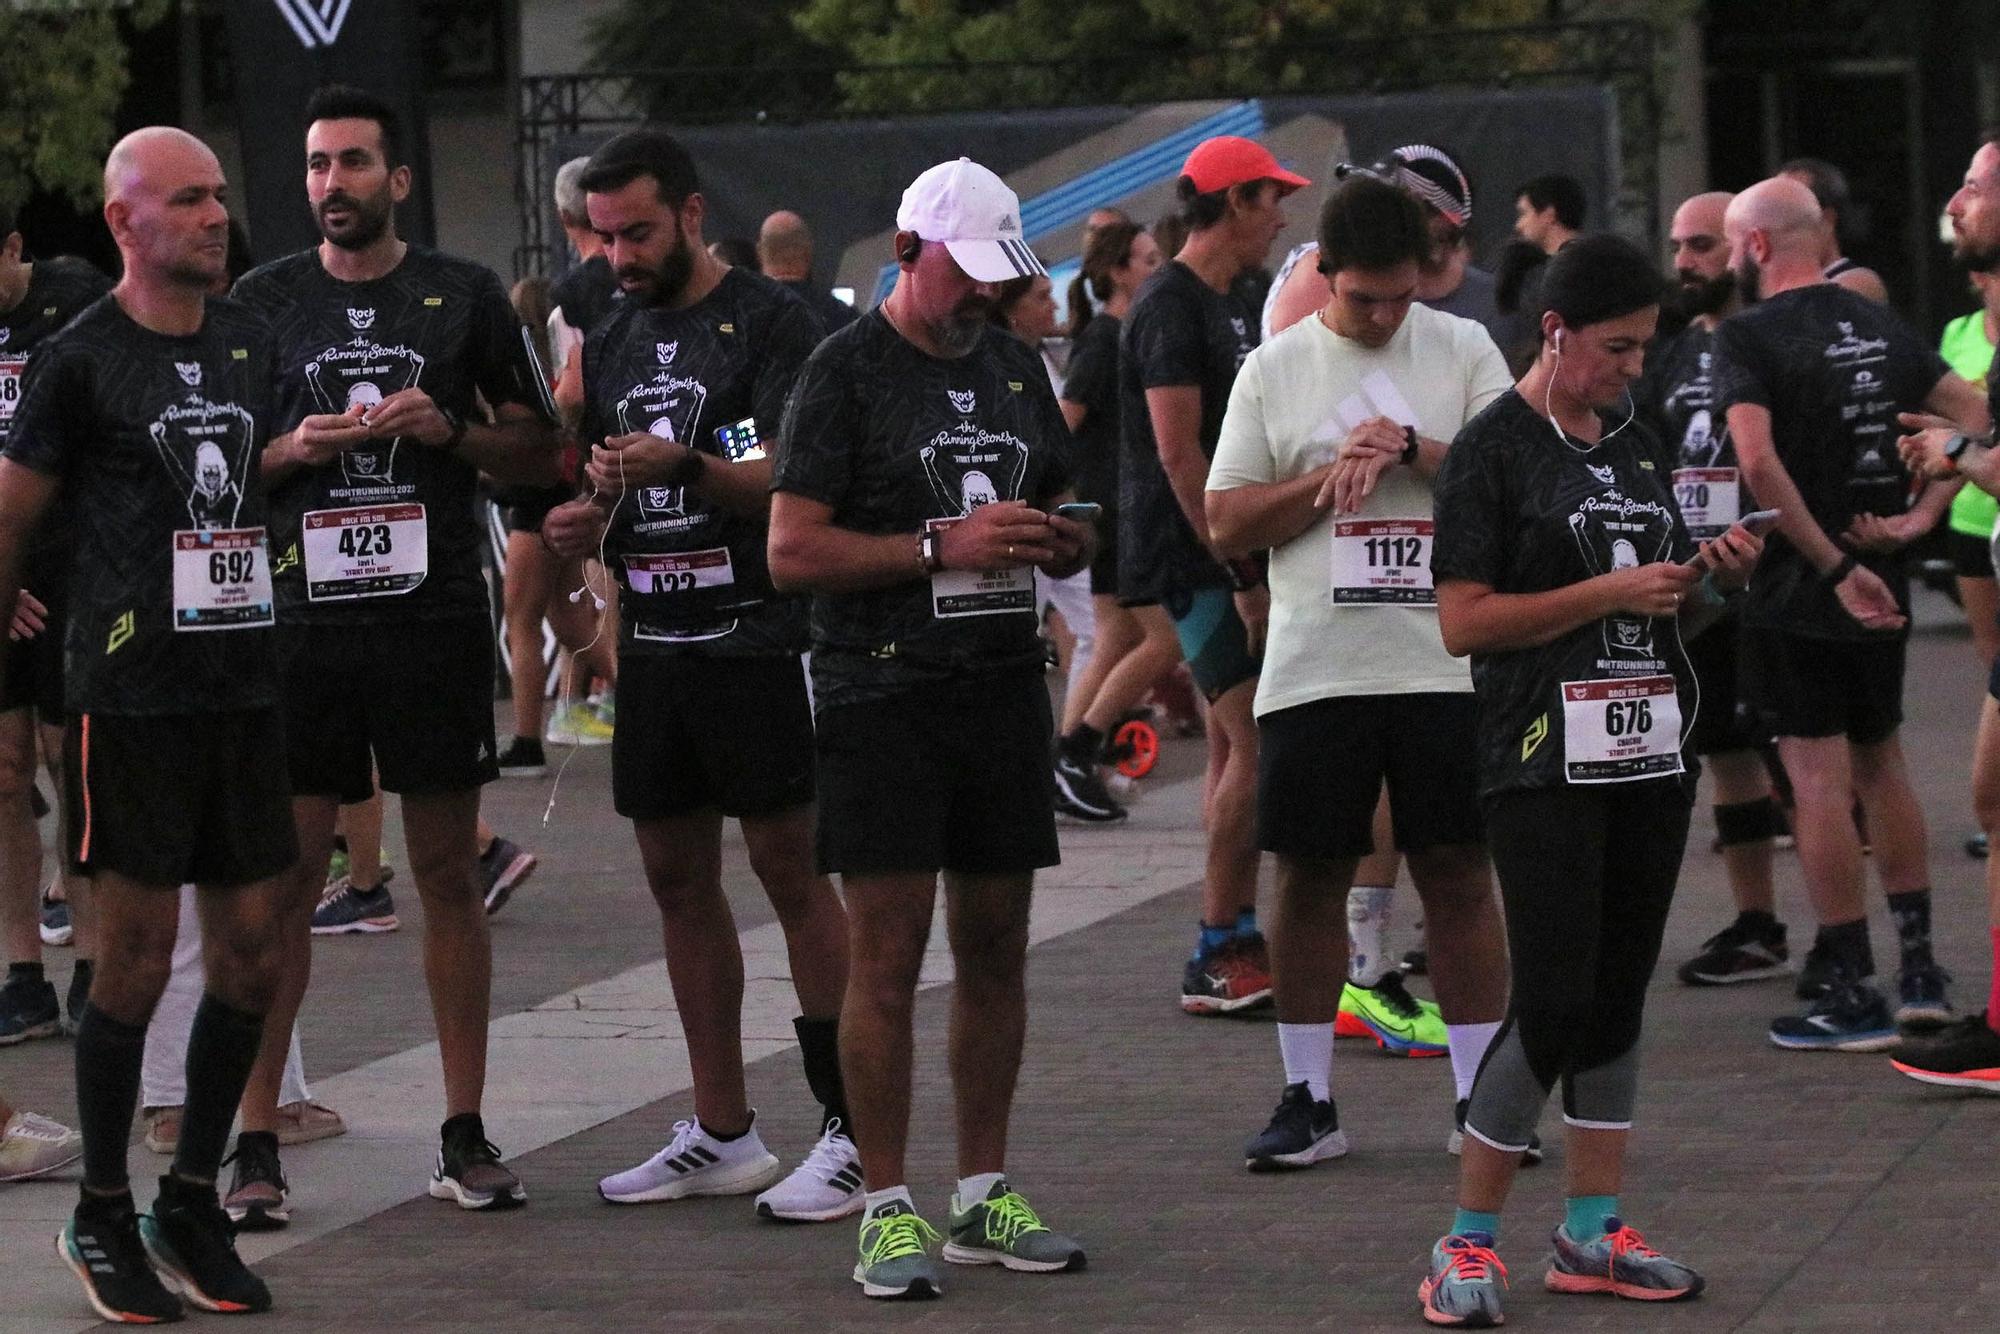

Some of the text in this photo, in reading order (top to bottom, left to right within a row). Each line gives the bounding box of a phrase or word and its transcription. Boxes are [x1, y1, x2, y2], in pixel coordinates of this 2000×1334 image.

[346, 308, 376, 320] Rock
[347, 336, 371, 347] the
[316, 347, 368, 366] Running
[0, 377, 17, 401] 8
[947, 389, 975, 403] Rock
[954, 420, 977, 433] the
[930, 431, 976, 453] Running
[329, 486, 396, 498] NIGHTRUNNING
[1580, 497, 1625, 520] Running
[338, 525, 392, 557] 423
[1364, 537, 1422, 567] 1112
[209, 550, 253, 585] 692
[1605, 698, 1653, 736] 676
